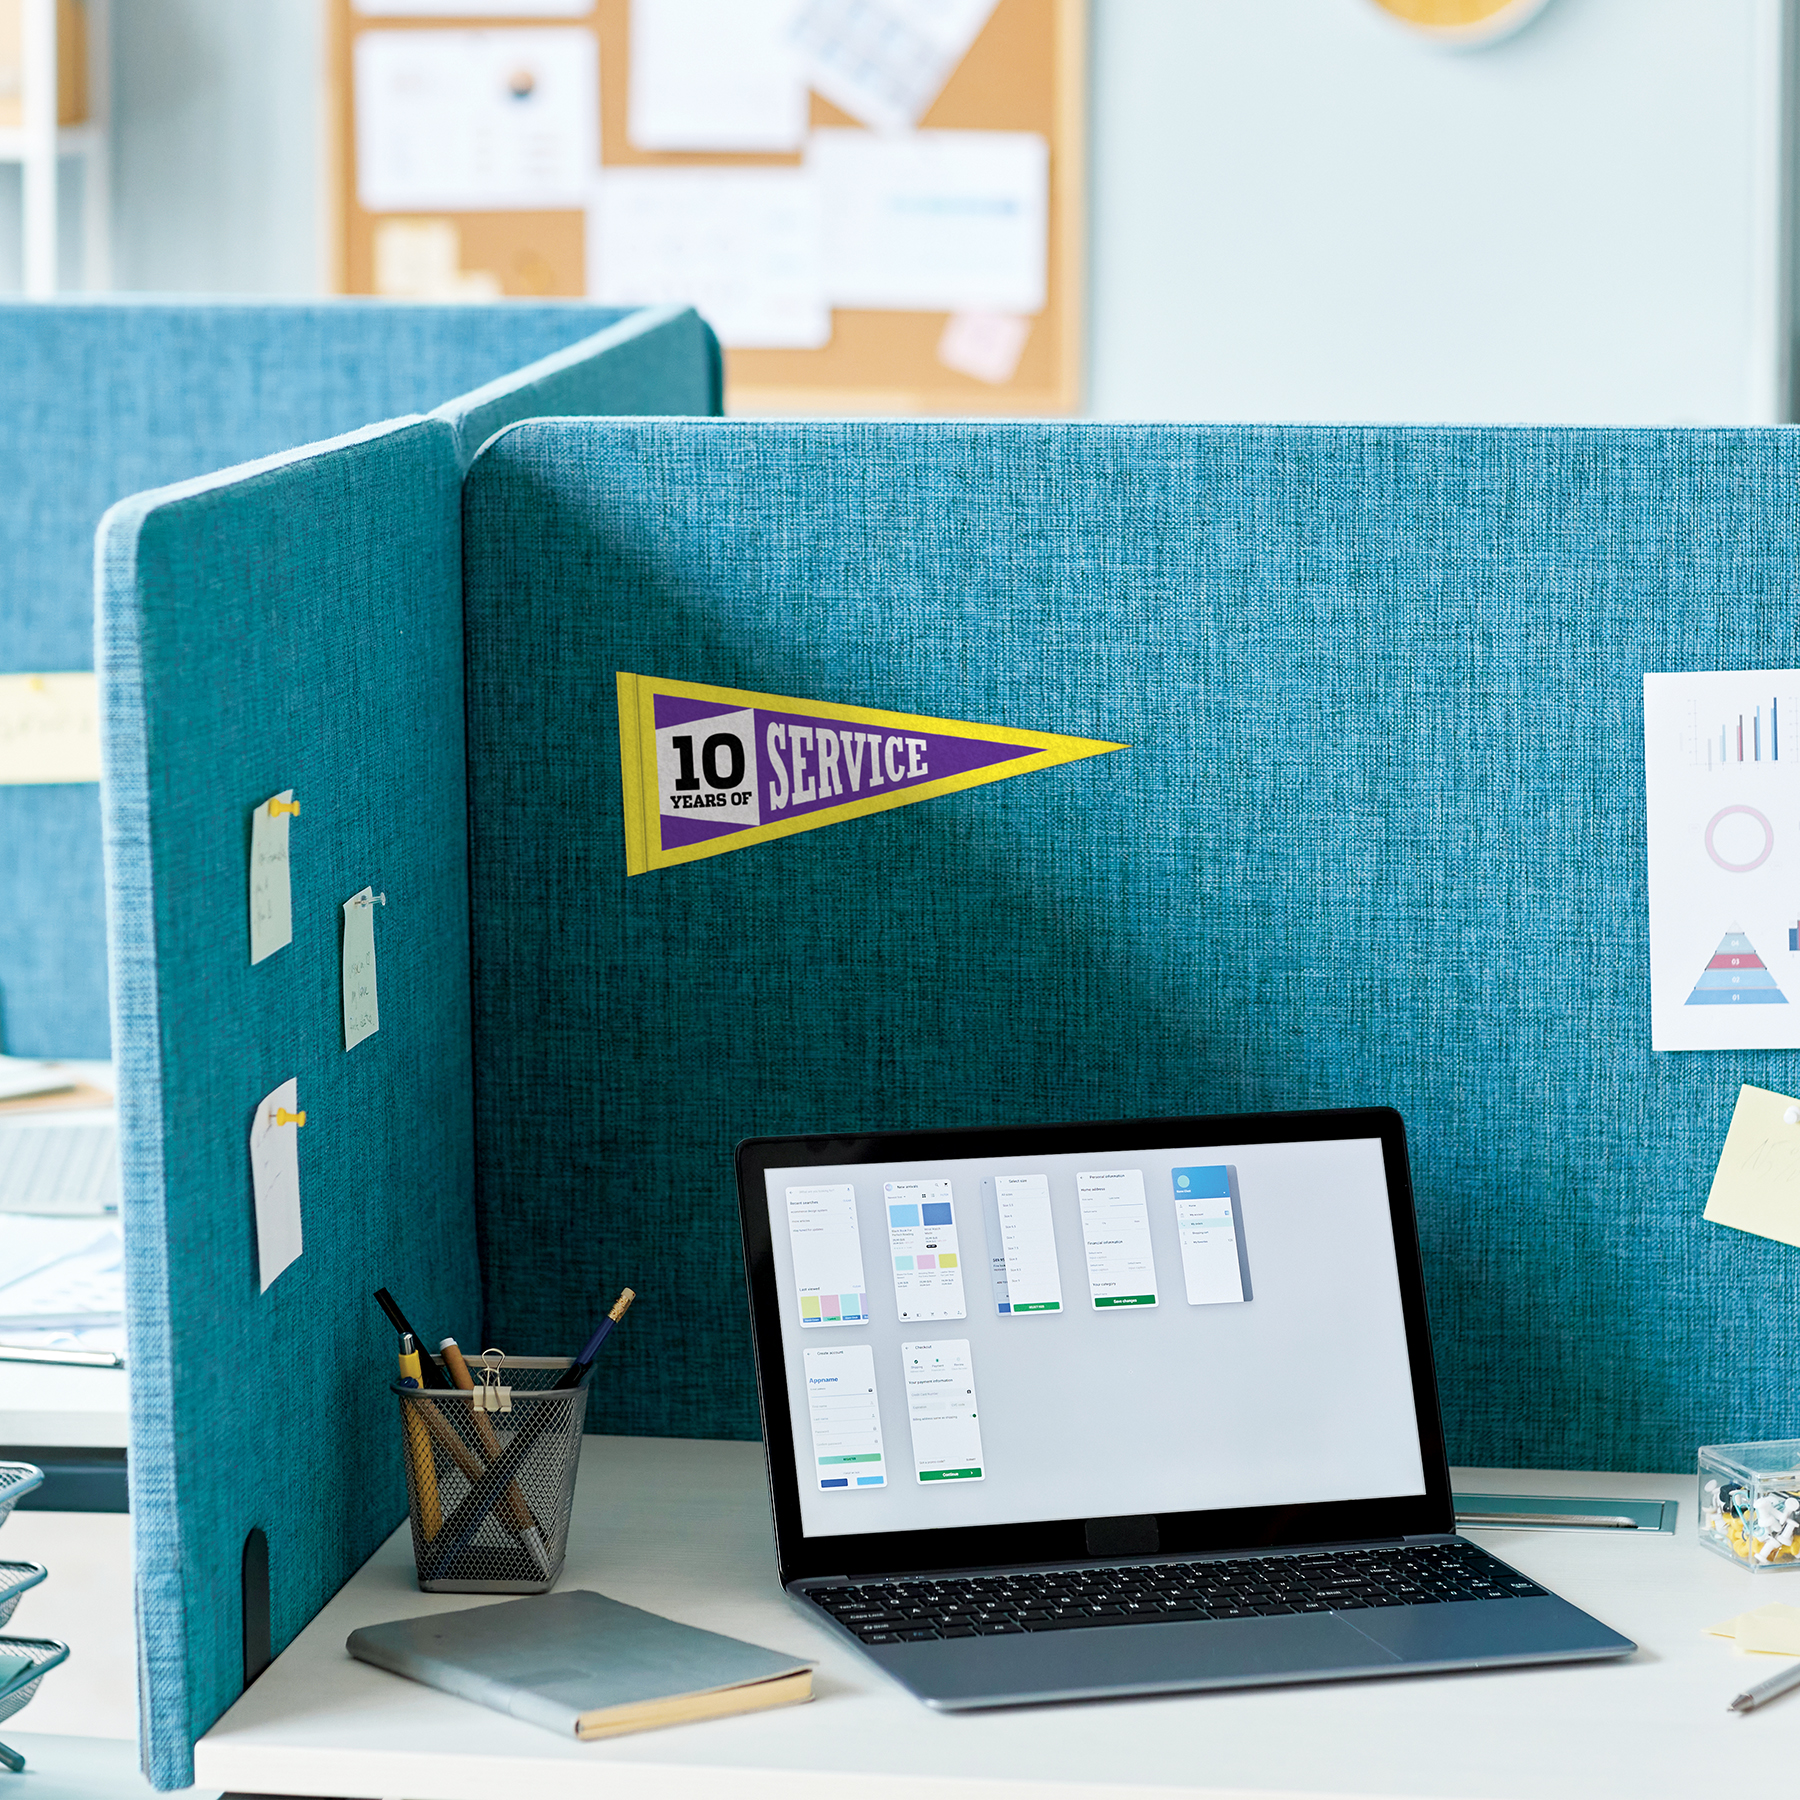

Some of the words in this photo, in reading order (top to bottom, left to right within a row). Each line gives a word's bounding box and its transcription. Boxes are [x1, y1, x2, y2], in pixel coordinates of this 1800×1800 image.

[672, 732, 746, 791] 10
[766, 721, 929, 811] SERVICE
[669, 793, 727, 809] YEARS
[731, 791, 753, 806] OF
[1731, 976, 1740, 984] 02
